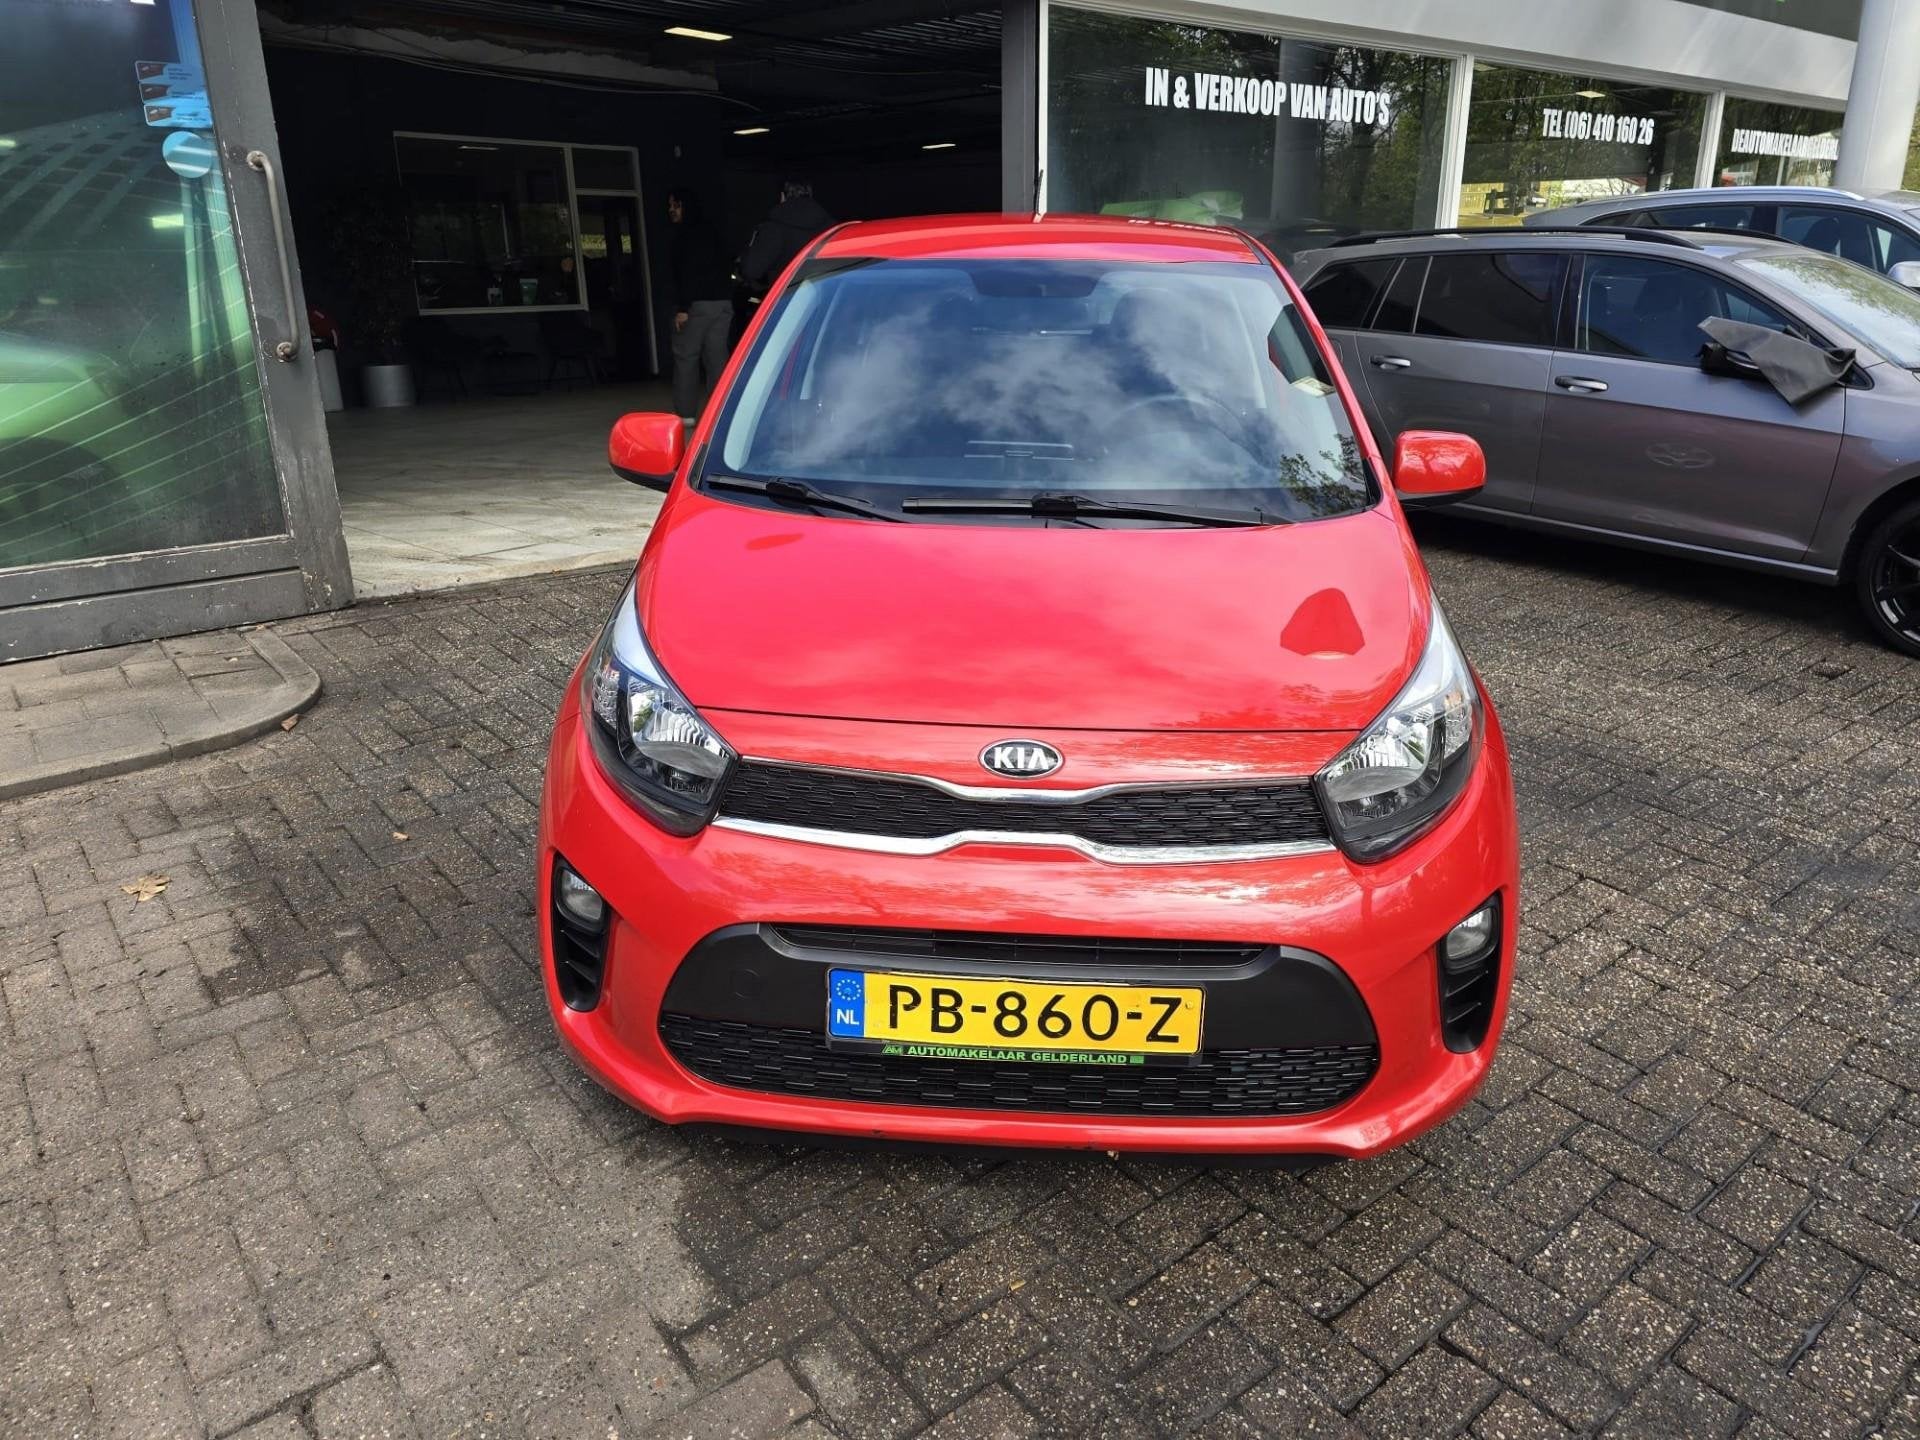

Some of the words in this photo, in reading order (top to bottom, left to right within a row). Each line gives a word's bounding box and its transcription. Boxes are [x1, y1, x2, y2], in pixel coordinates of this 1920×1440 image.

[1145, 67, 1169, 107] IN
[1173, 76, 1190, 109] &
[1194, 72, 1287, 116] VERKOOP
[1290, 83, 1327, 121] VAN
[1328, 87, 1390, 126] AUTO'S
[1542, 108, 1563, 138] TEL
[1564, 110, 1592, 140] (06)
[1592, 113, 1615, 142] 410
[1616, 116, 1638, 144] 160
[1637, 117, 1655, 146] 26
[993, 746, 1049, 770] KIA
[836, 1008, 860, 1026] NL
[888, 983, 1184, 1044] PB-860-Z
[907, 1045, 1026, 1061] AUTOMAKELAAR
[1031, 1053, 1127, 1065] GELDERLAND
